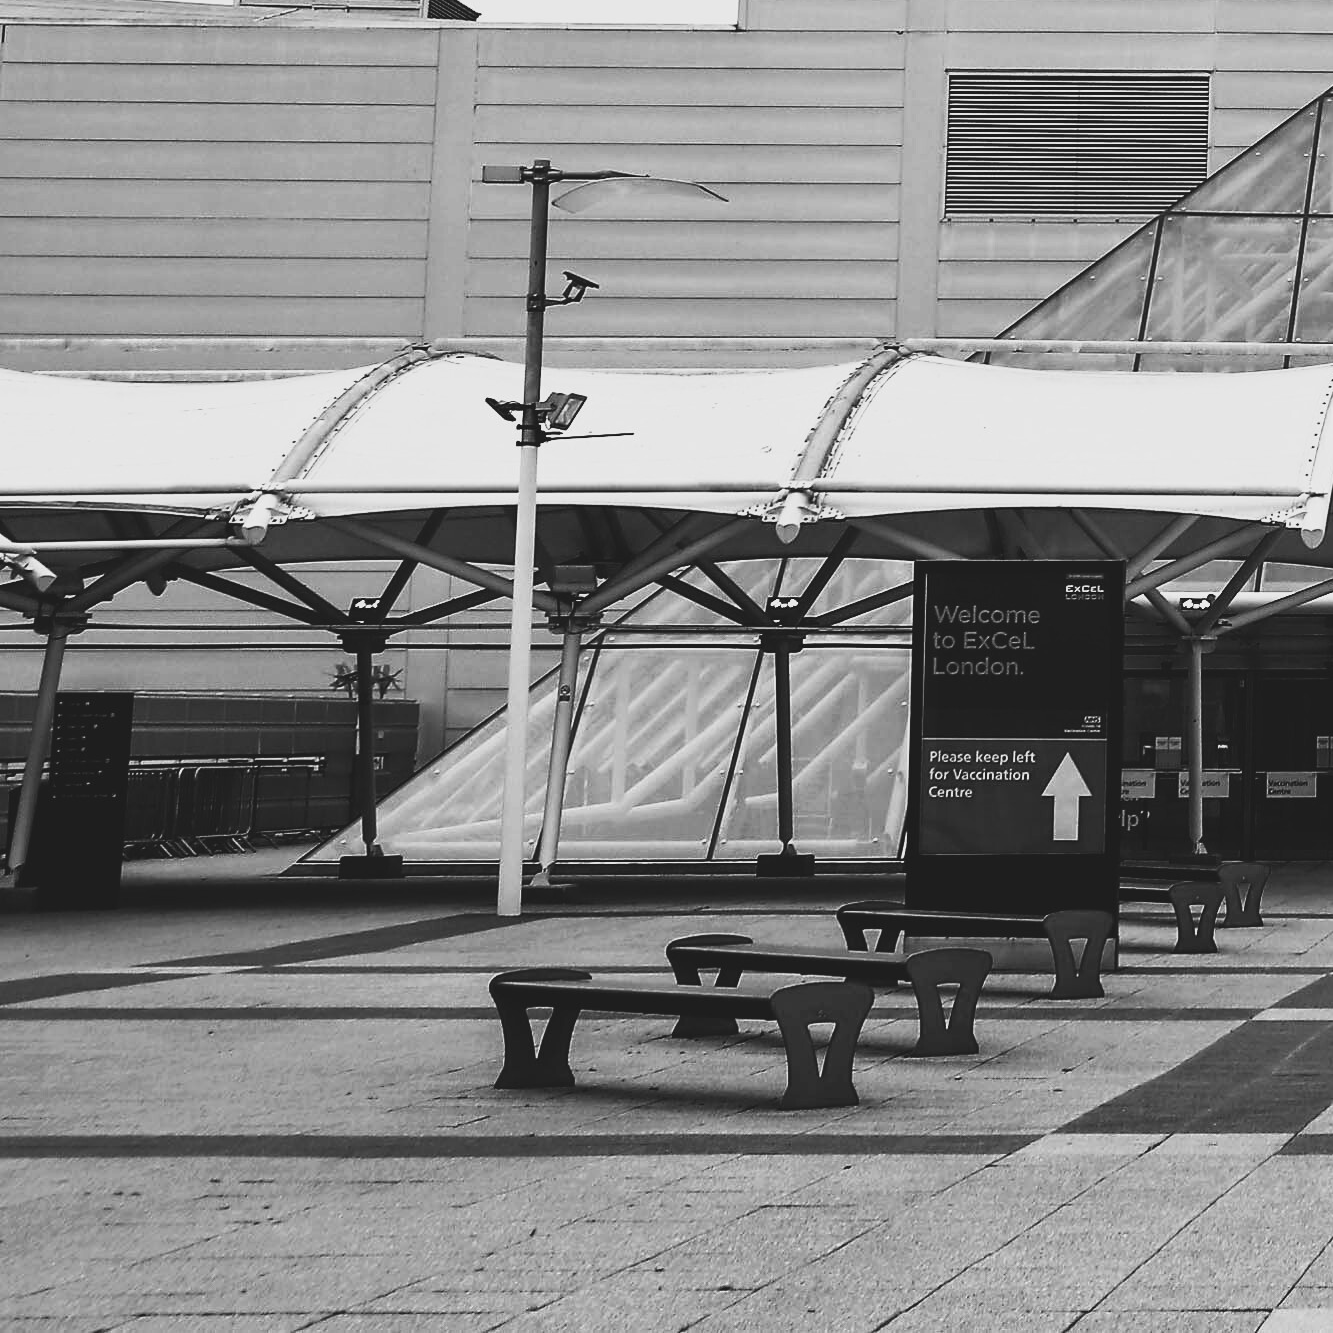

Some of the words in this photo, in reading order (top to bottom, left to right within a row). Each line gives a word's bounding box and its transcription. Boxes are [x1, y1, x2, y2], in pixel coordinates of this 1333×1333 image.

[934, 605, 1040, 623] Welcome
[933, 632, 955, 649] to
[964, 631, 1035, 649] ExCeL
[933, 657, 1024, 675] London.
[929, 750, 972, 763] Please
[976, 750, 1009, 766] keep
[1013, 750, 1036, 763] left
[929, 767, 950, 781] for
[953, 768, 1030, 781] Vaccination
[928, 786, 973, 798] Centre
